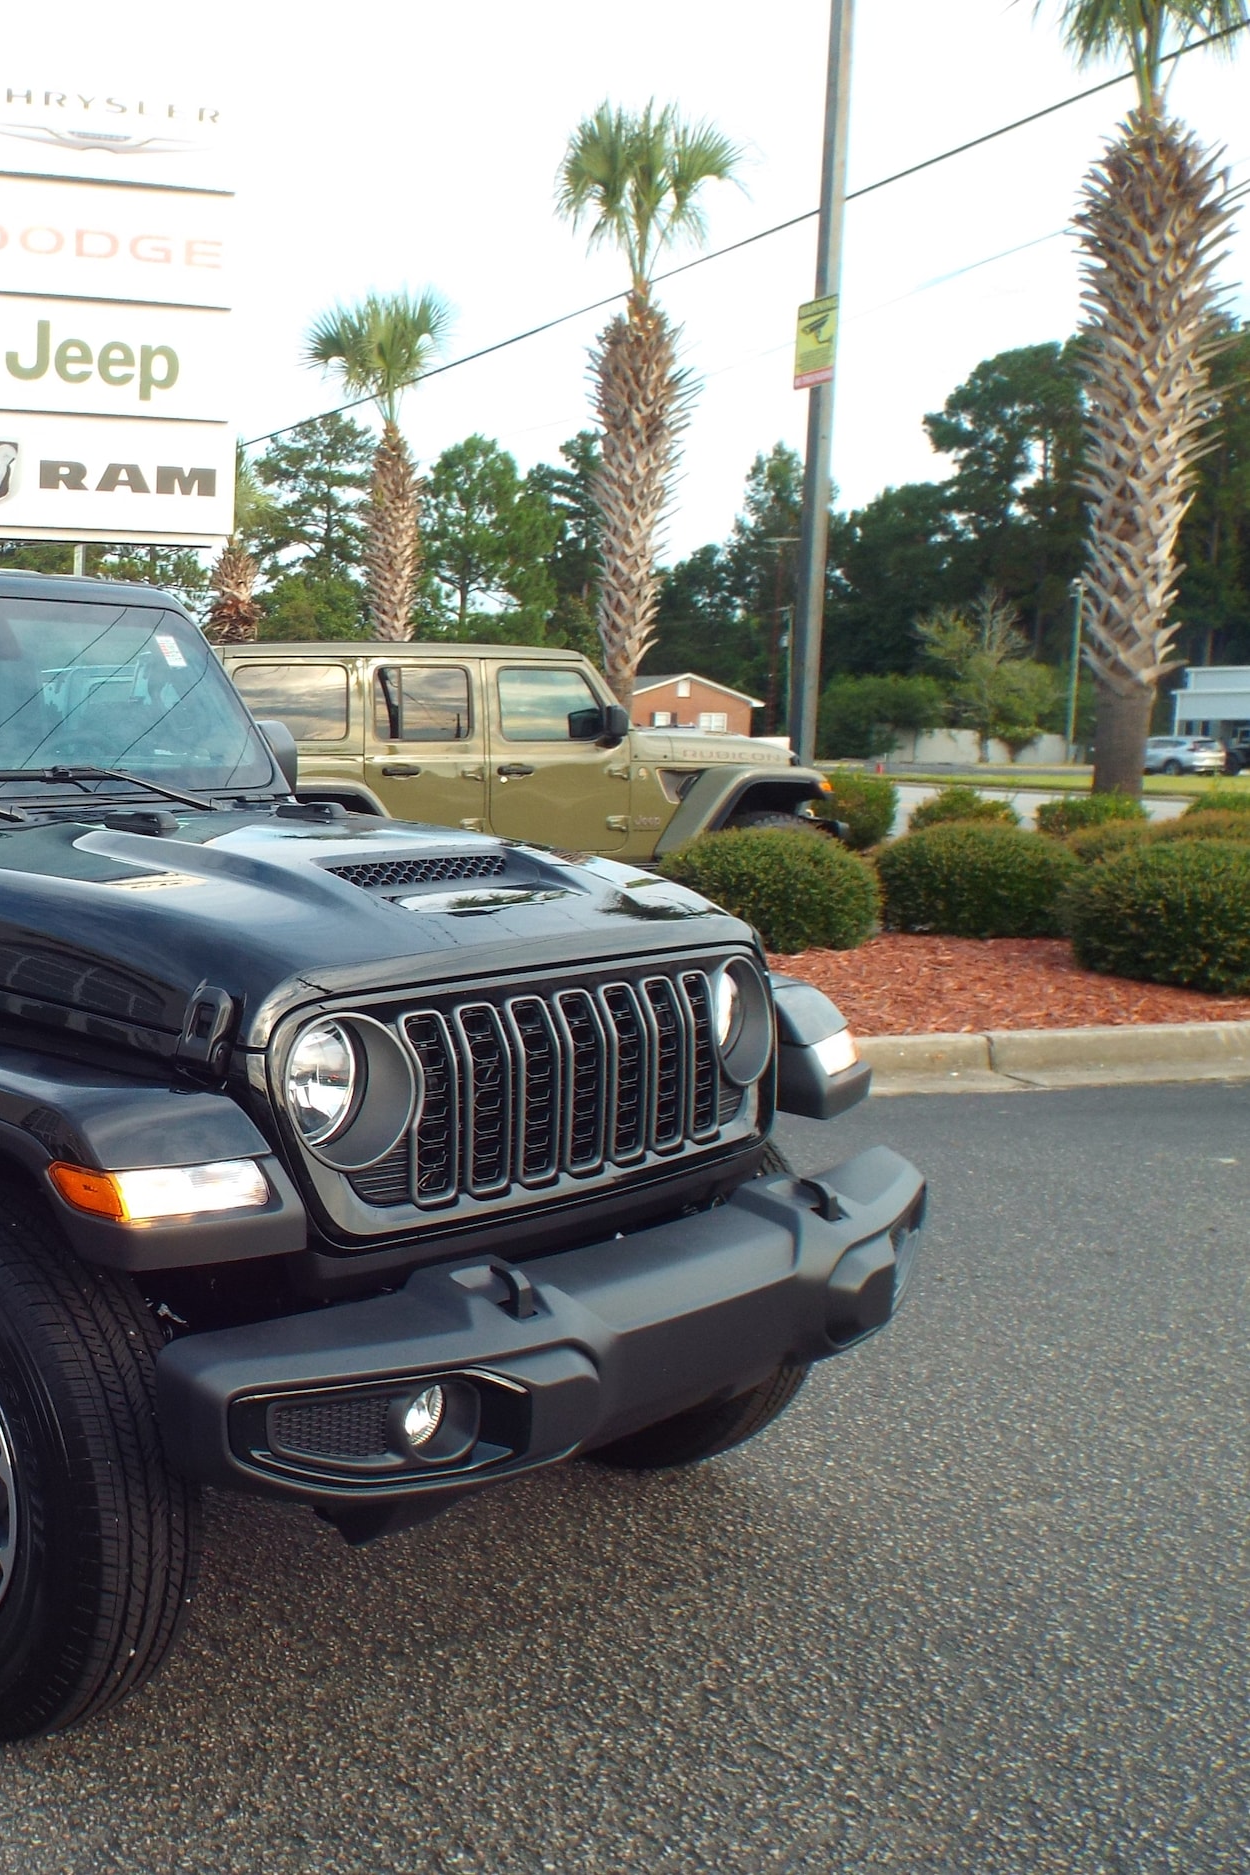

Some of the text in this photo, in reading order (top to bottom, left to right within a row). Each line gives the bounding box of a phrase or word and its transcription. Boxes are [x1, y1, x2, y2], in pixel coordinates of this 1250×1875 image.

[5, 320, 180, 401] Jeep
[39, 459, 217, 497] RAM
[683, 749, 781, 762] RUBICON
